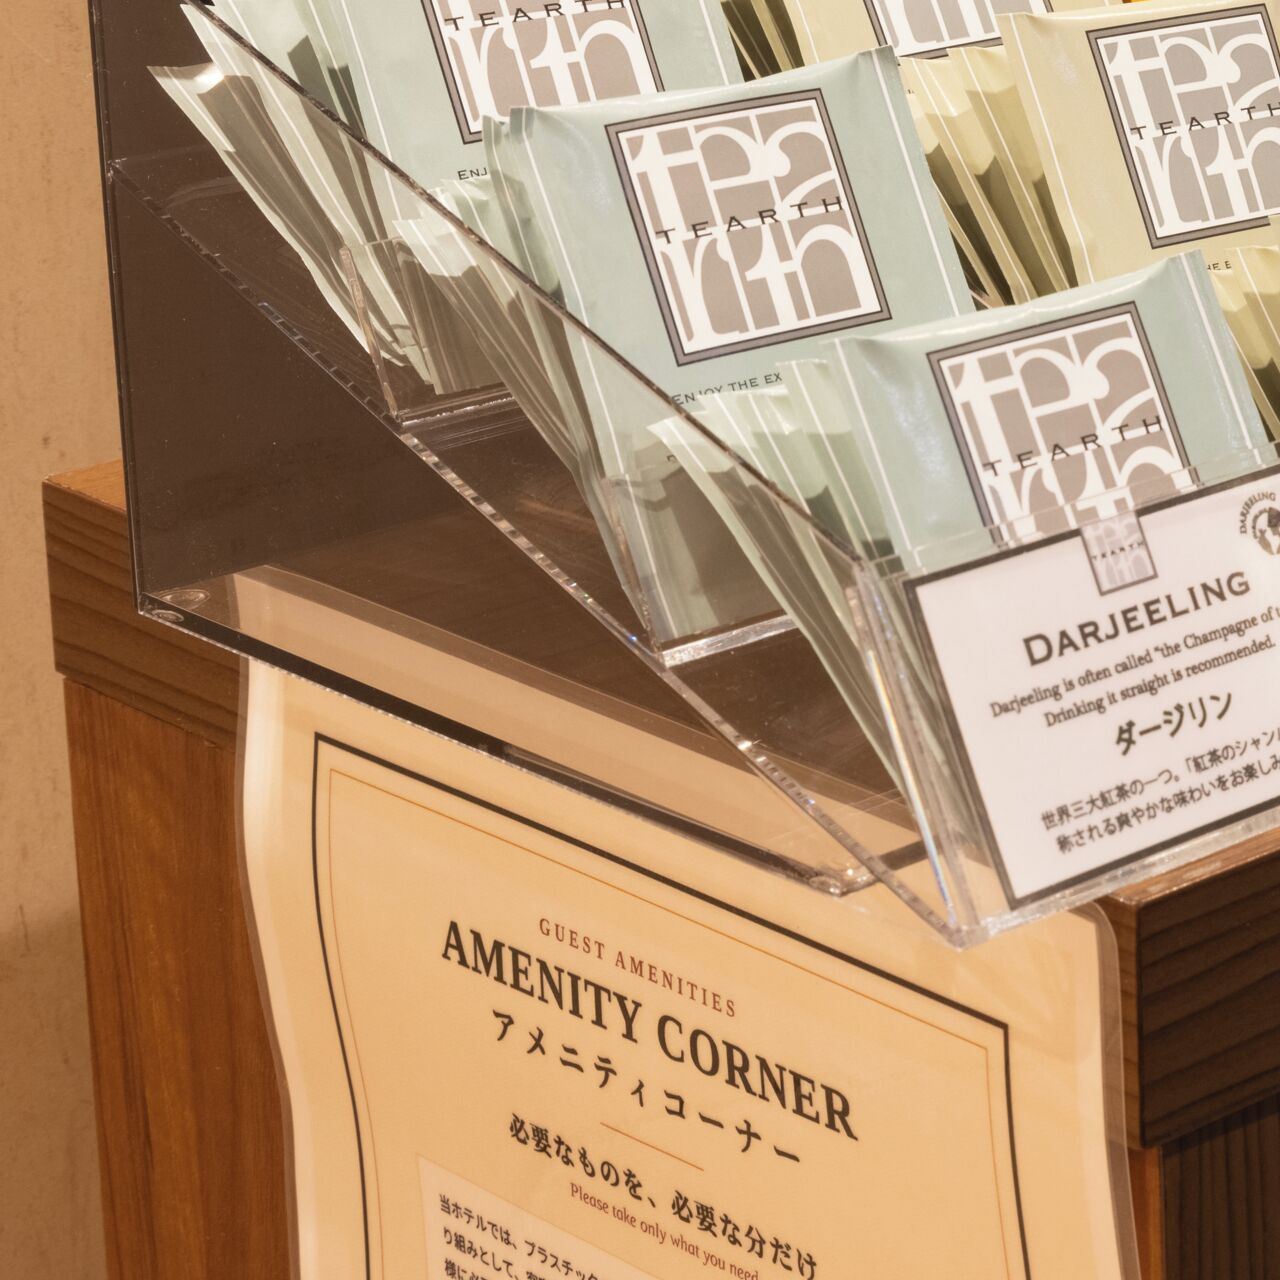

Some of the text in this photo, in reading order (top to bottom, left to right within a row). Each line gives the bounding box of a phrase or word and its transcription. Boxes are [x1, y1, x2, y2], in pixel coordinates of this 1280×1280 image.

[656, 196, 844, 245] TEARTH
[728, 378, 758, 394] THE
[983, 415, 1164, 478] TEARTH
[989, 684, 1063, 718] Darjeeling
[1062, 678, 1076, 693] is
[1077, 667, 1113, 687] often
[1114, 648, 1154, 675] called
[1182, 616, 1259, 650] Champagne
[1260, 605, 1275, 624] of
[1022, 571, 1251, 667] DARJEELING
[1043, 634, 1276, 728] Drinking it straight is recommended.
[1115, 692, 1232, 757] ダージリン
[538, 918, 736, 1018] GUEST AMENITIES
[441, 919, 860, 1142] AMENITY CORNER
[492, 1008, 801, 1164] アメニティコーナー
[508, 1112, 818, 1280] 必要なものを、必要な分だけ
[570, 1182, 609, 1215] Please
[612, 1206, 637, 1228] take
[640, 1220, 667, 1245] only
[669, 1232, 700, 1257] what
[702, 1251, 726, 1271] you
